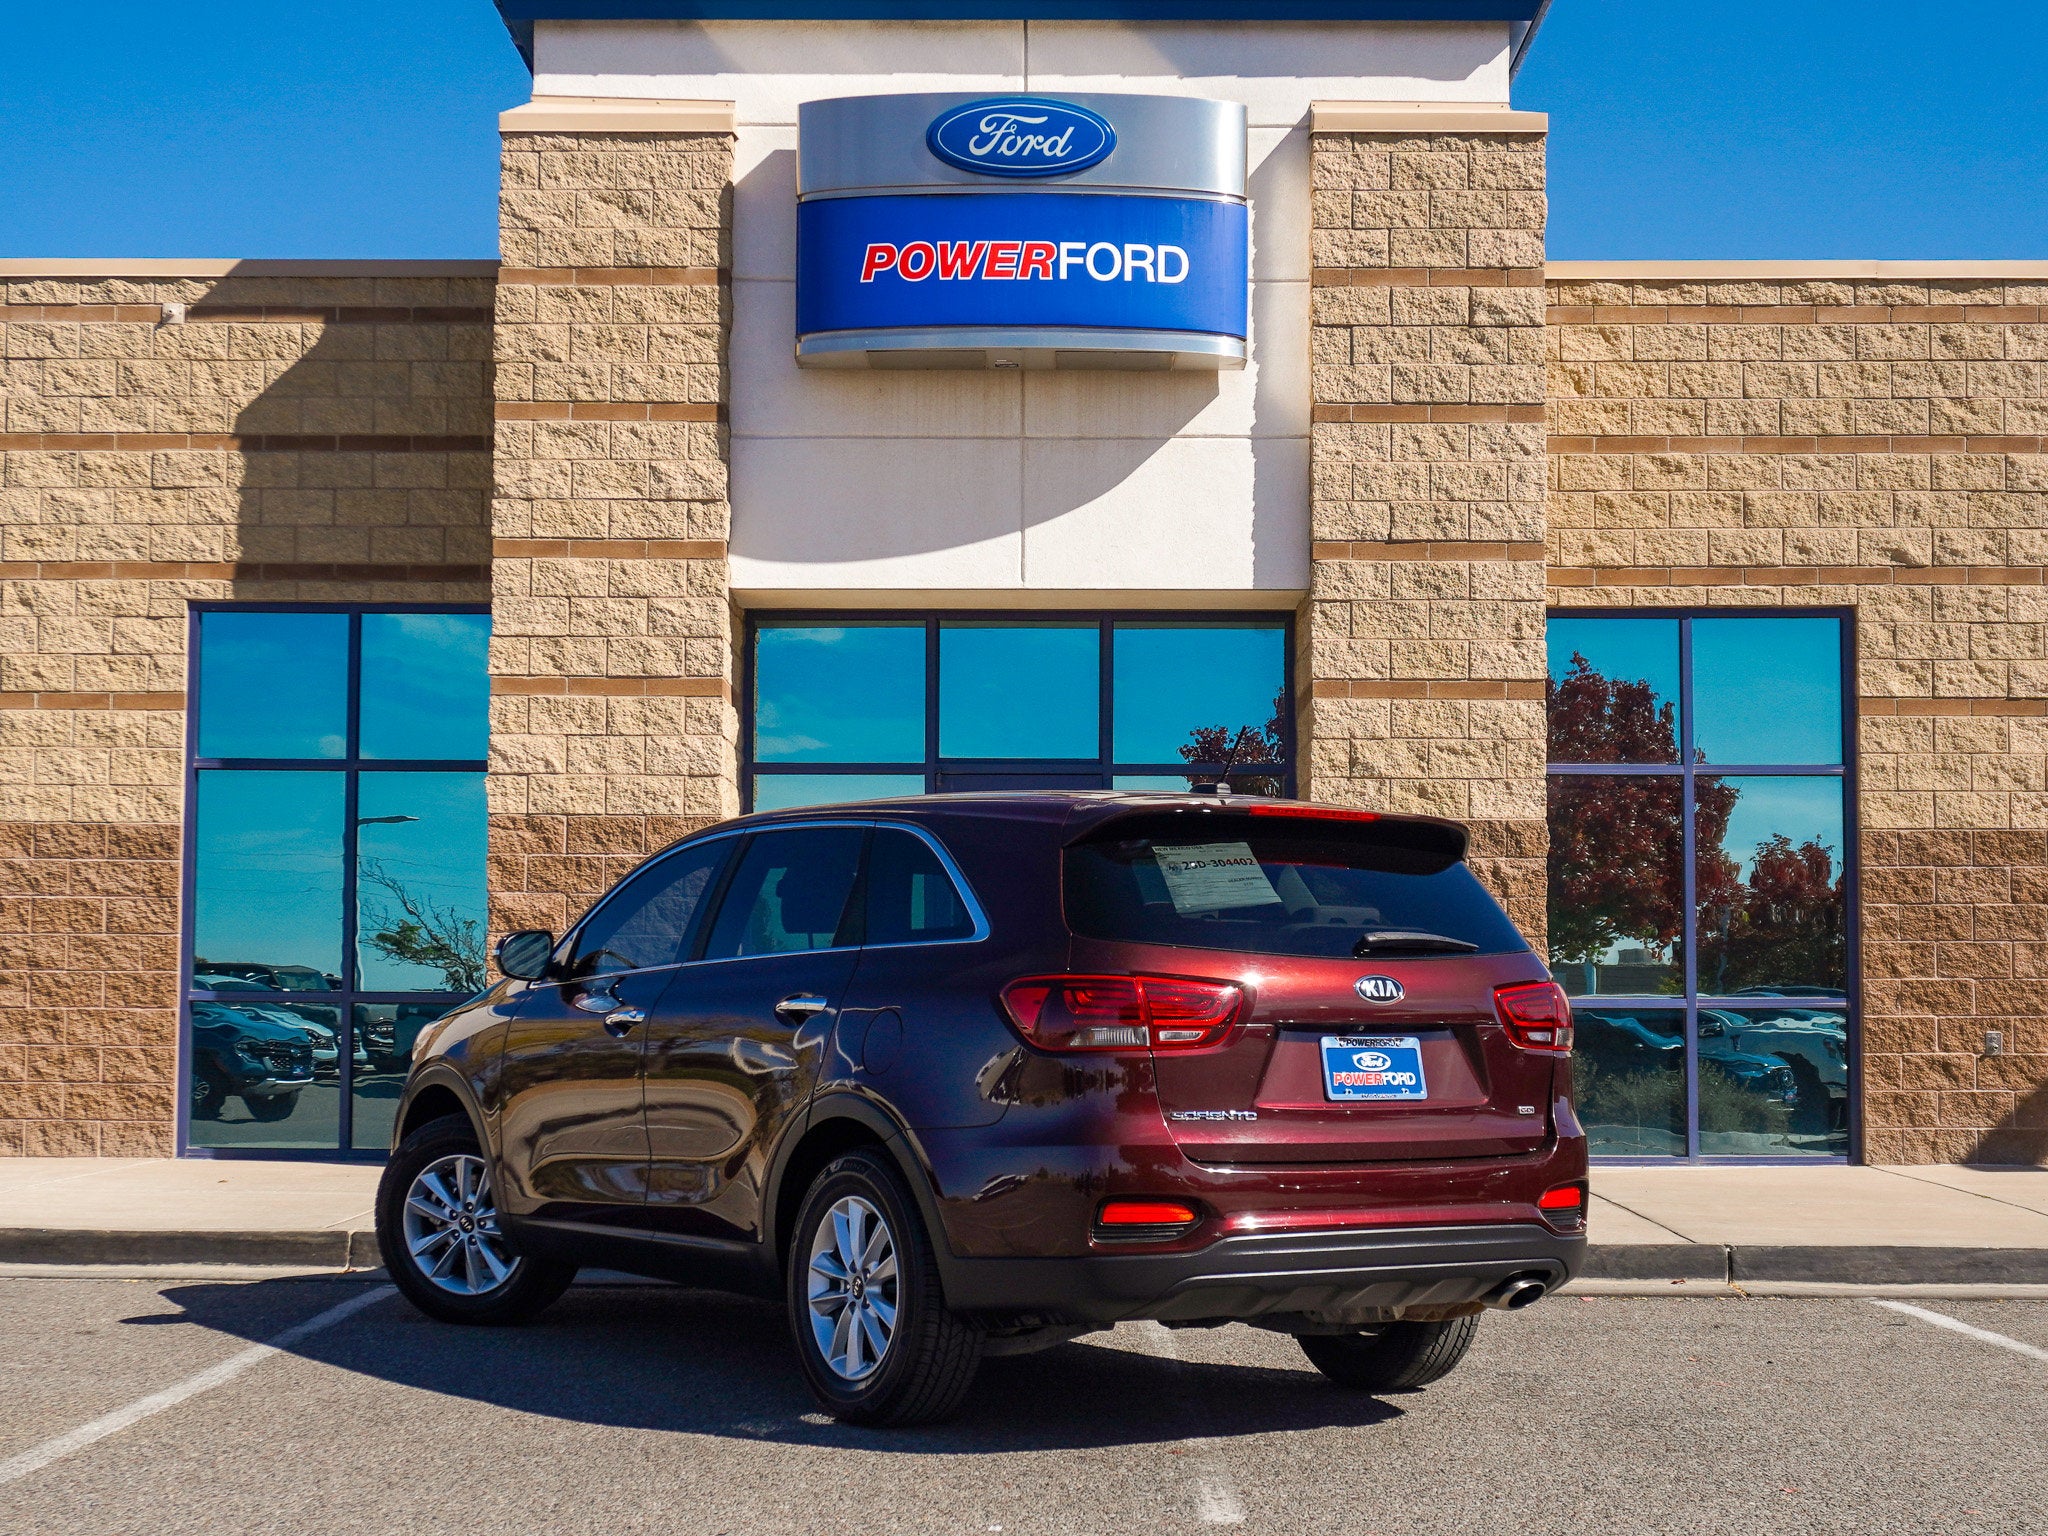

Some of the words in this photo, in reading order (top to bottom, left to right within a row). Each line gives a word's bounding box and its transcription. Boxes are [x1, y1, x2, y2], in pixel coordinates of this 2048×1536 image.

[968, 113, 1074, 157] Ford
[860, 240, 1189, 284] POWERFORD
[1361, 980, 1397, 997] KIA
[1333, 1072, 1416, 1086] POWERFORD
[1171, 1110, 1257, 1120] SORENTO
